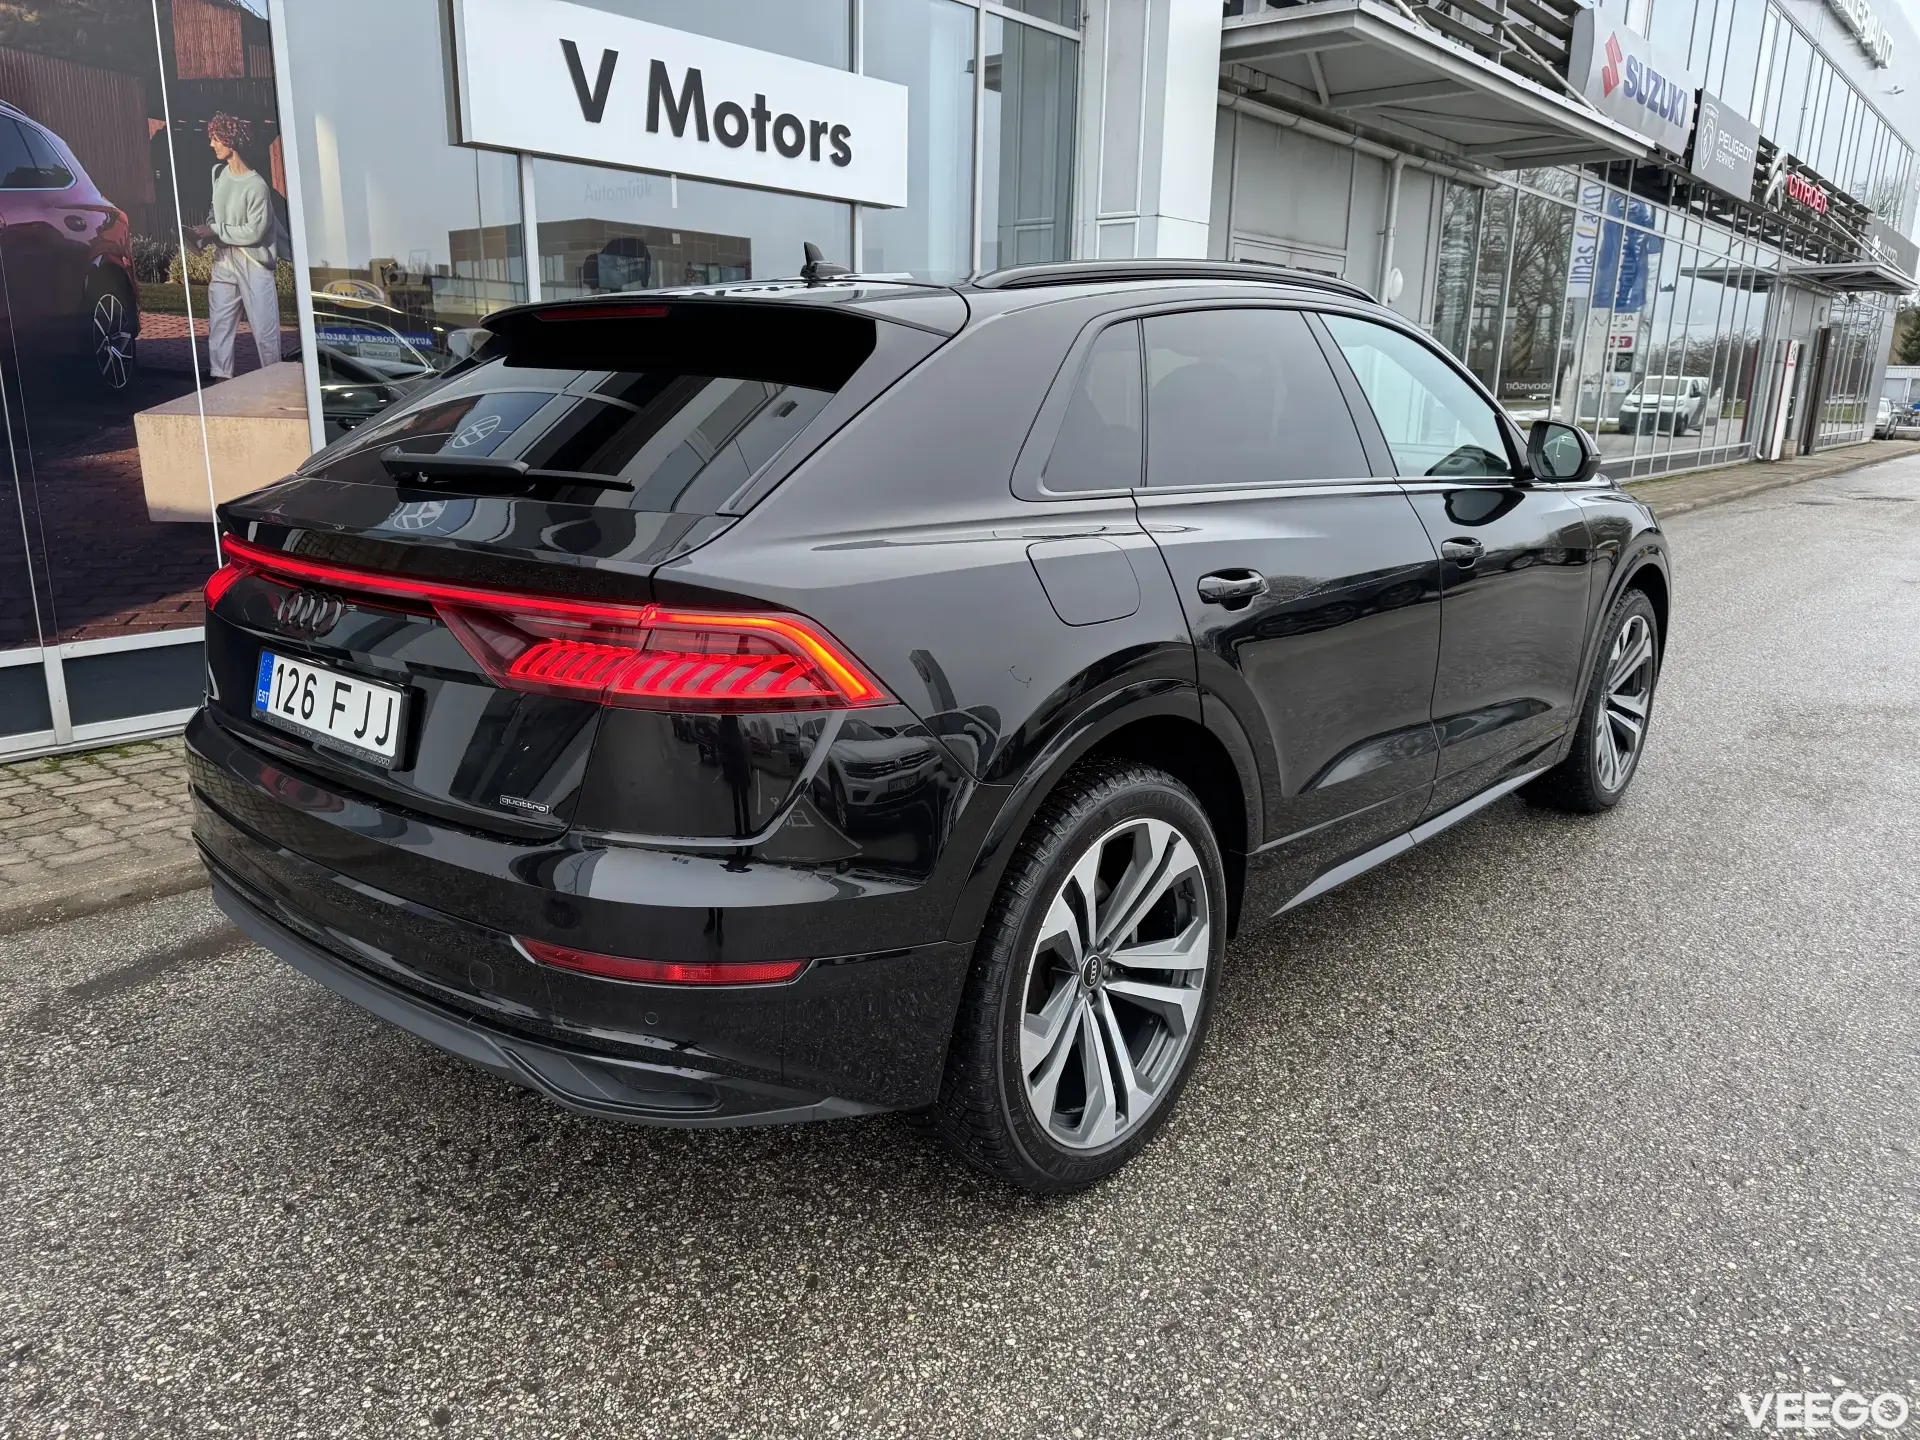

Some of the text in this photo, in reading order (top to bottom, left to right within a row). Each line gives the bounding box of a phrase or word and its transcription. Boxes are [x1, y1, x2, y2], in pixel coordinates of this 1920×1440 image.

[559, 38, 852, 167] V Motors
[1623, 54, 1688, 128] SUZUKI
[1715, 149, 1737, 170] SERVICE
[1718, 129, 1754, 163] PEUGEOT
[583, 177, 652, 203] Automüük
[258, 689, 270, 703] EST
[275, 663, 393, 746] 126 FJJ
[502, 798, 546, 812] quattro
